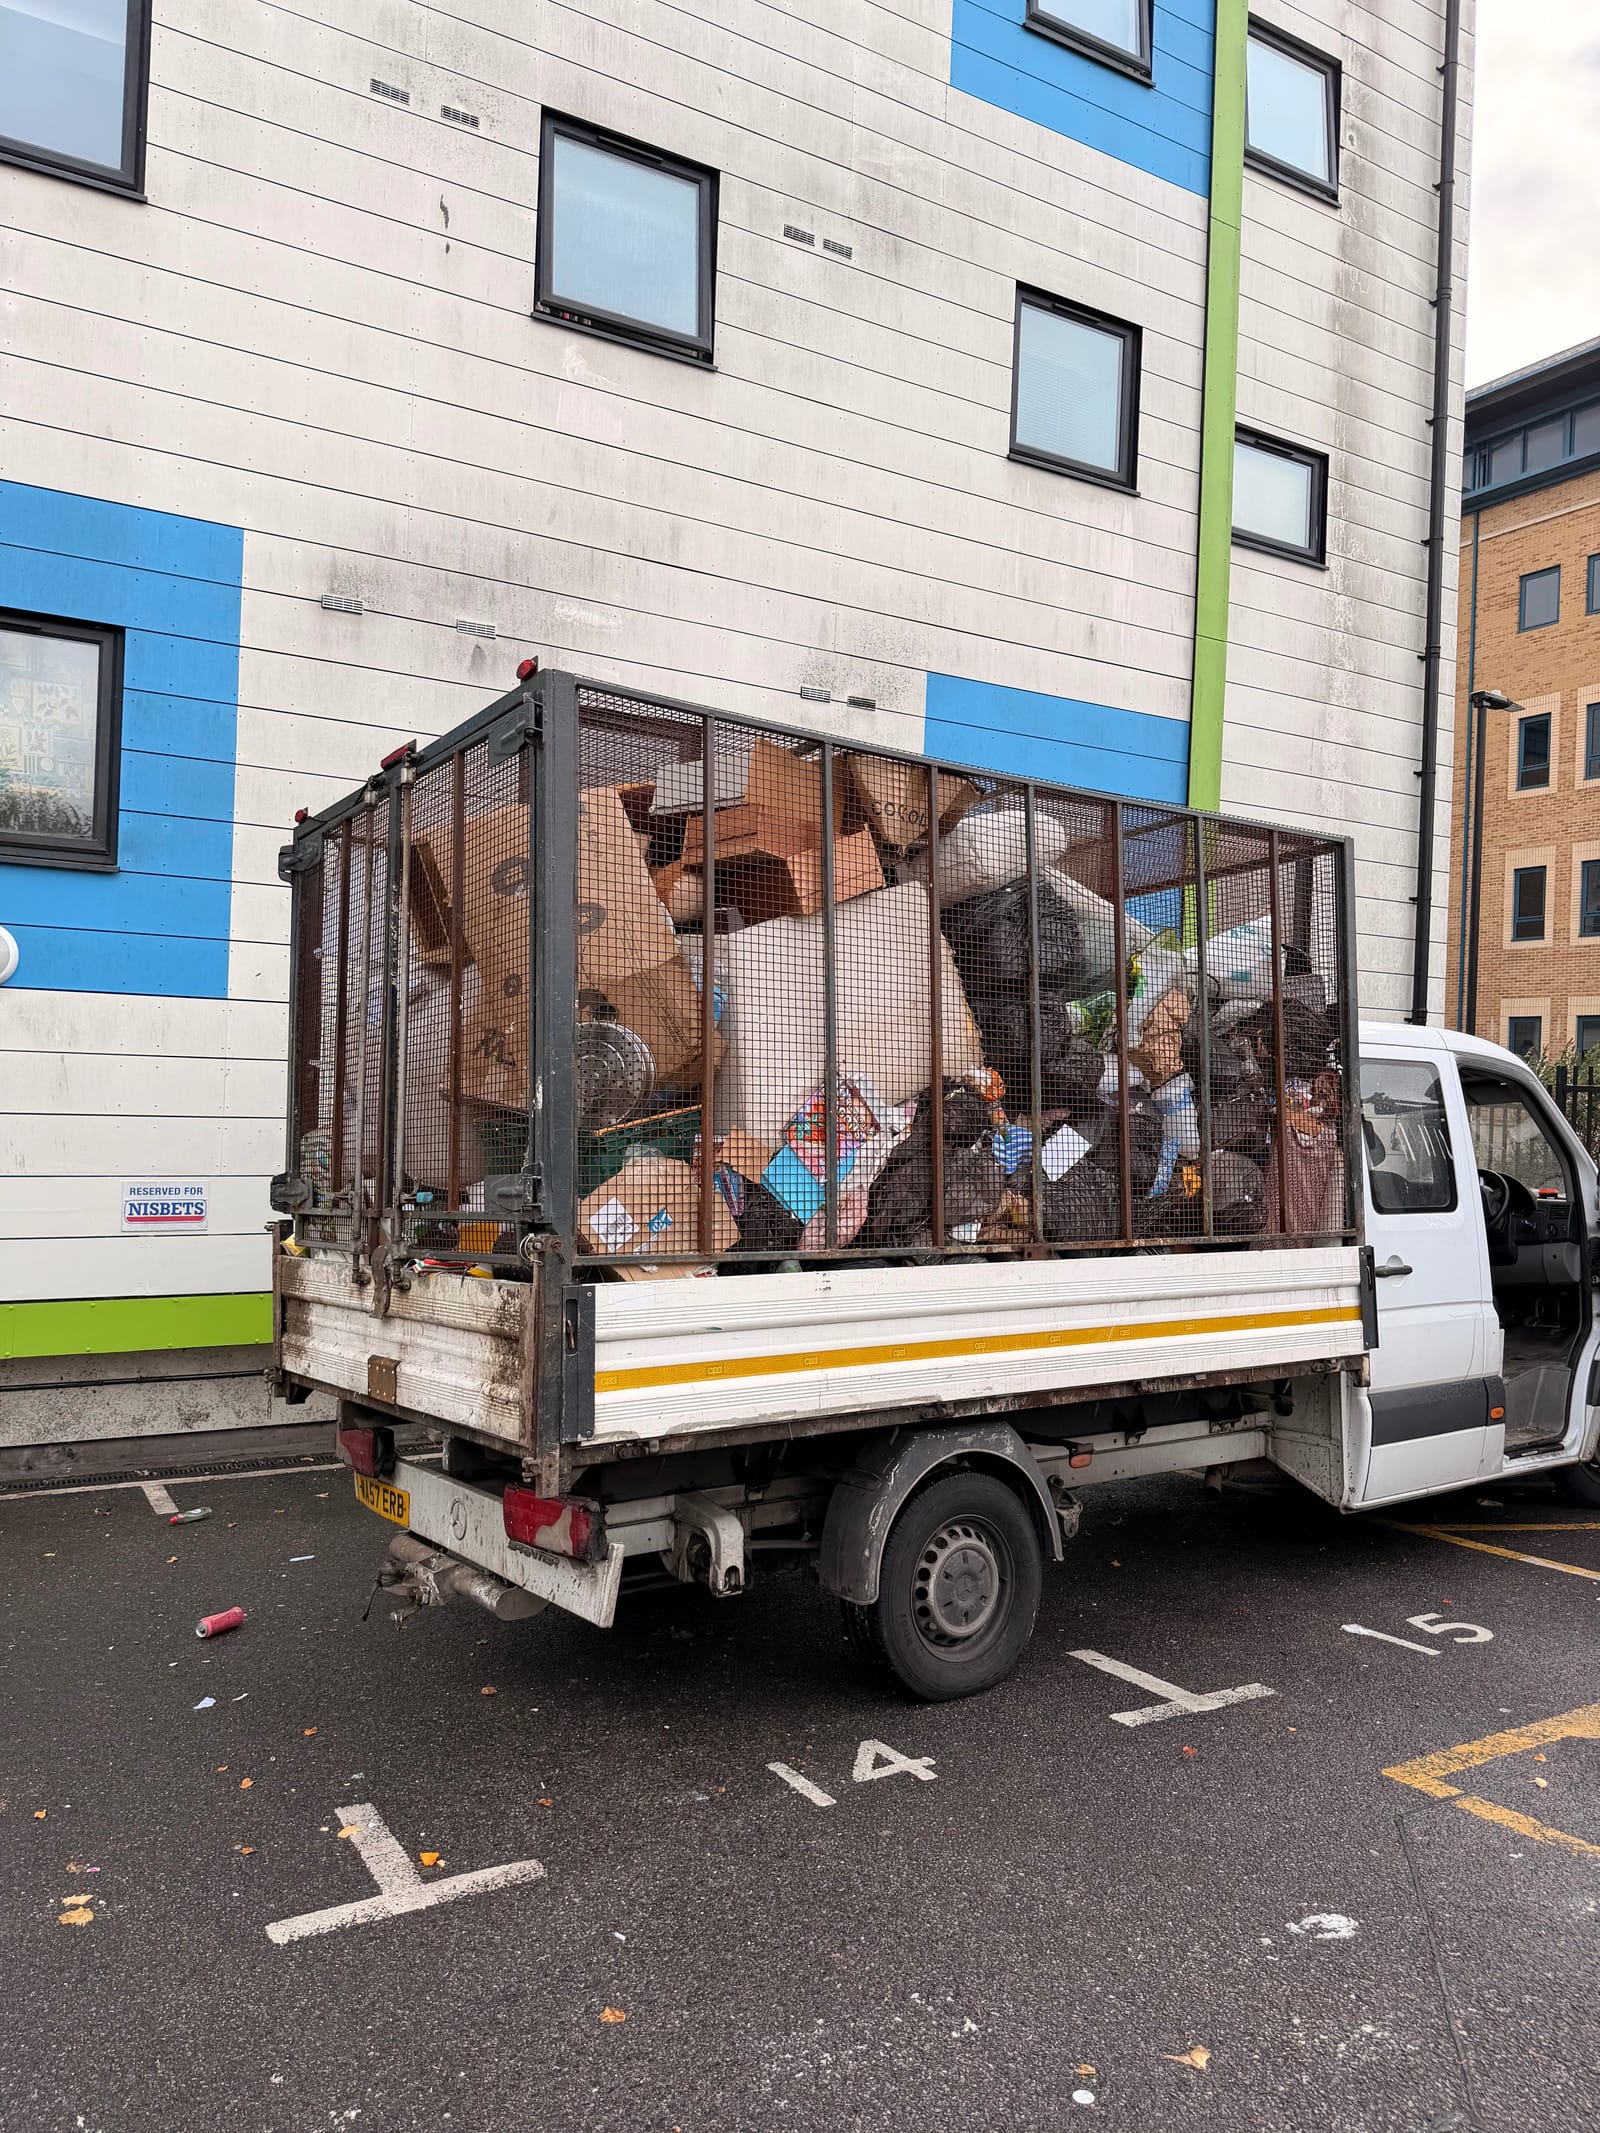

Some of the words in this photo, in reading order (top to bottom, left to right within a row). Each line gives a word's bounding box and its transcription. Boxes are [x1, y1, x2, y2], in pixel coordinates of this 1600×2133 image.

[129, 1187, 181, 1196] RESERVED
[184, 1186, 203, 1195] FOR
[128, 1202, 204, 1216] NISBETS
[382, 1487, 404, 1519] ERB
[1341, 1602, 1495, 1656] 15
[765, 1739, 939, 1807] 14
